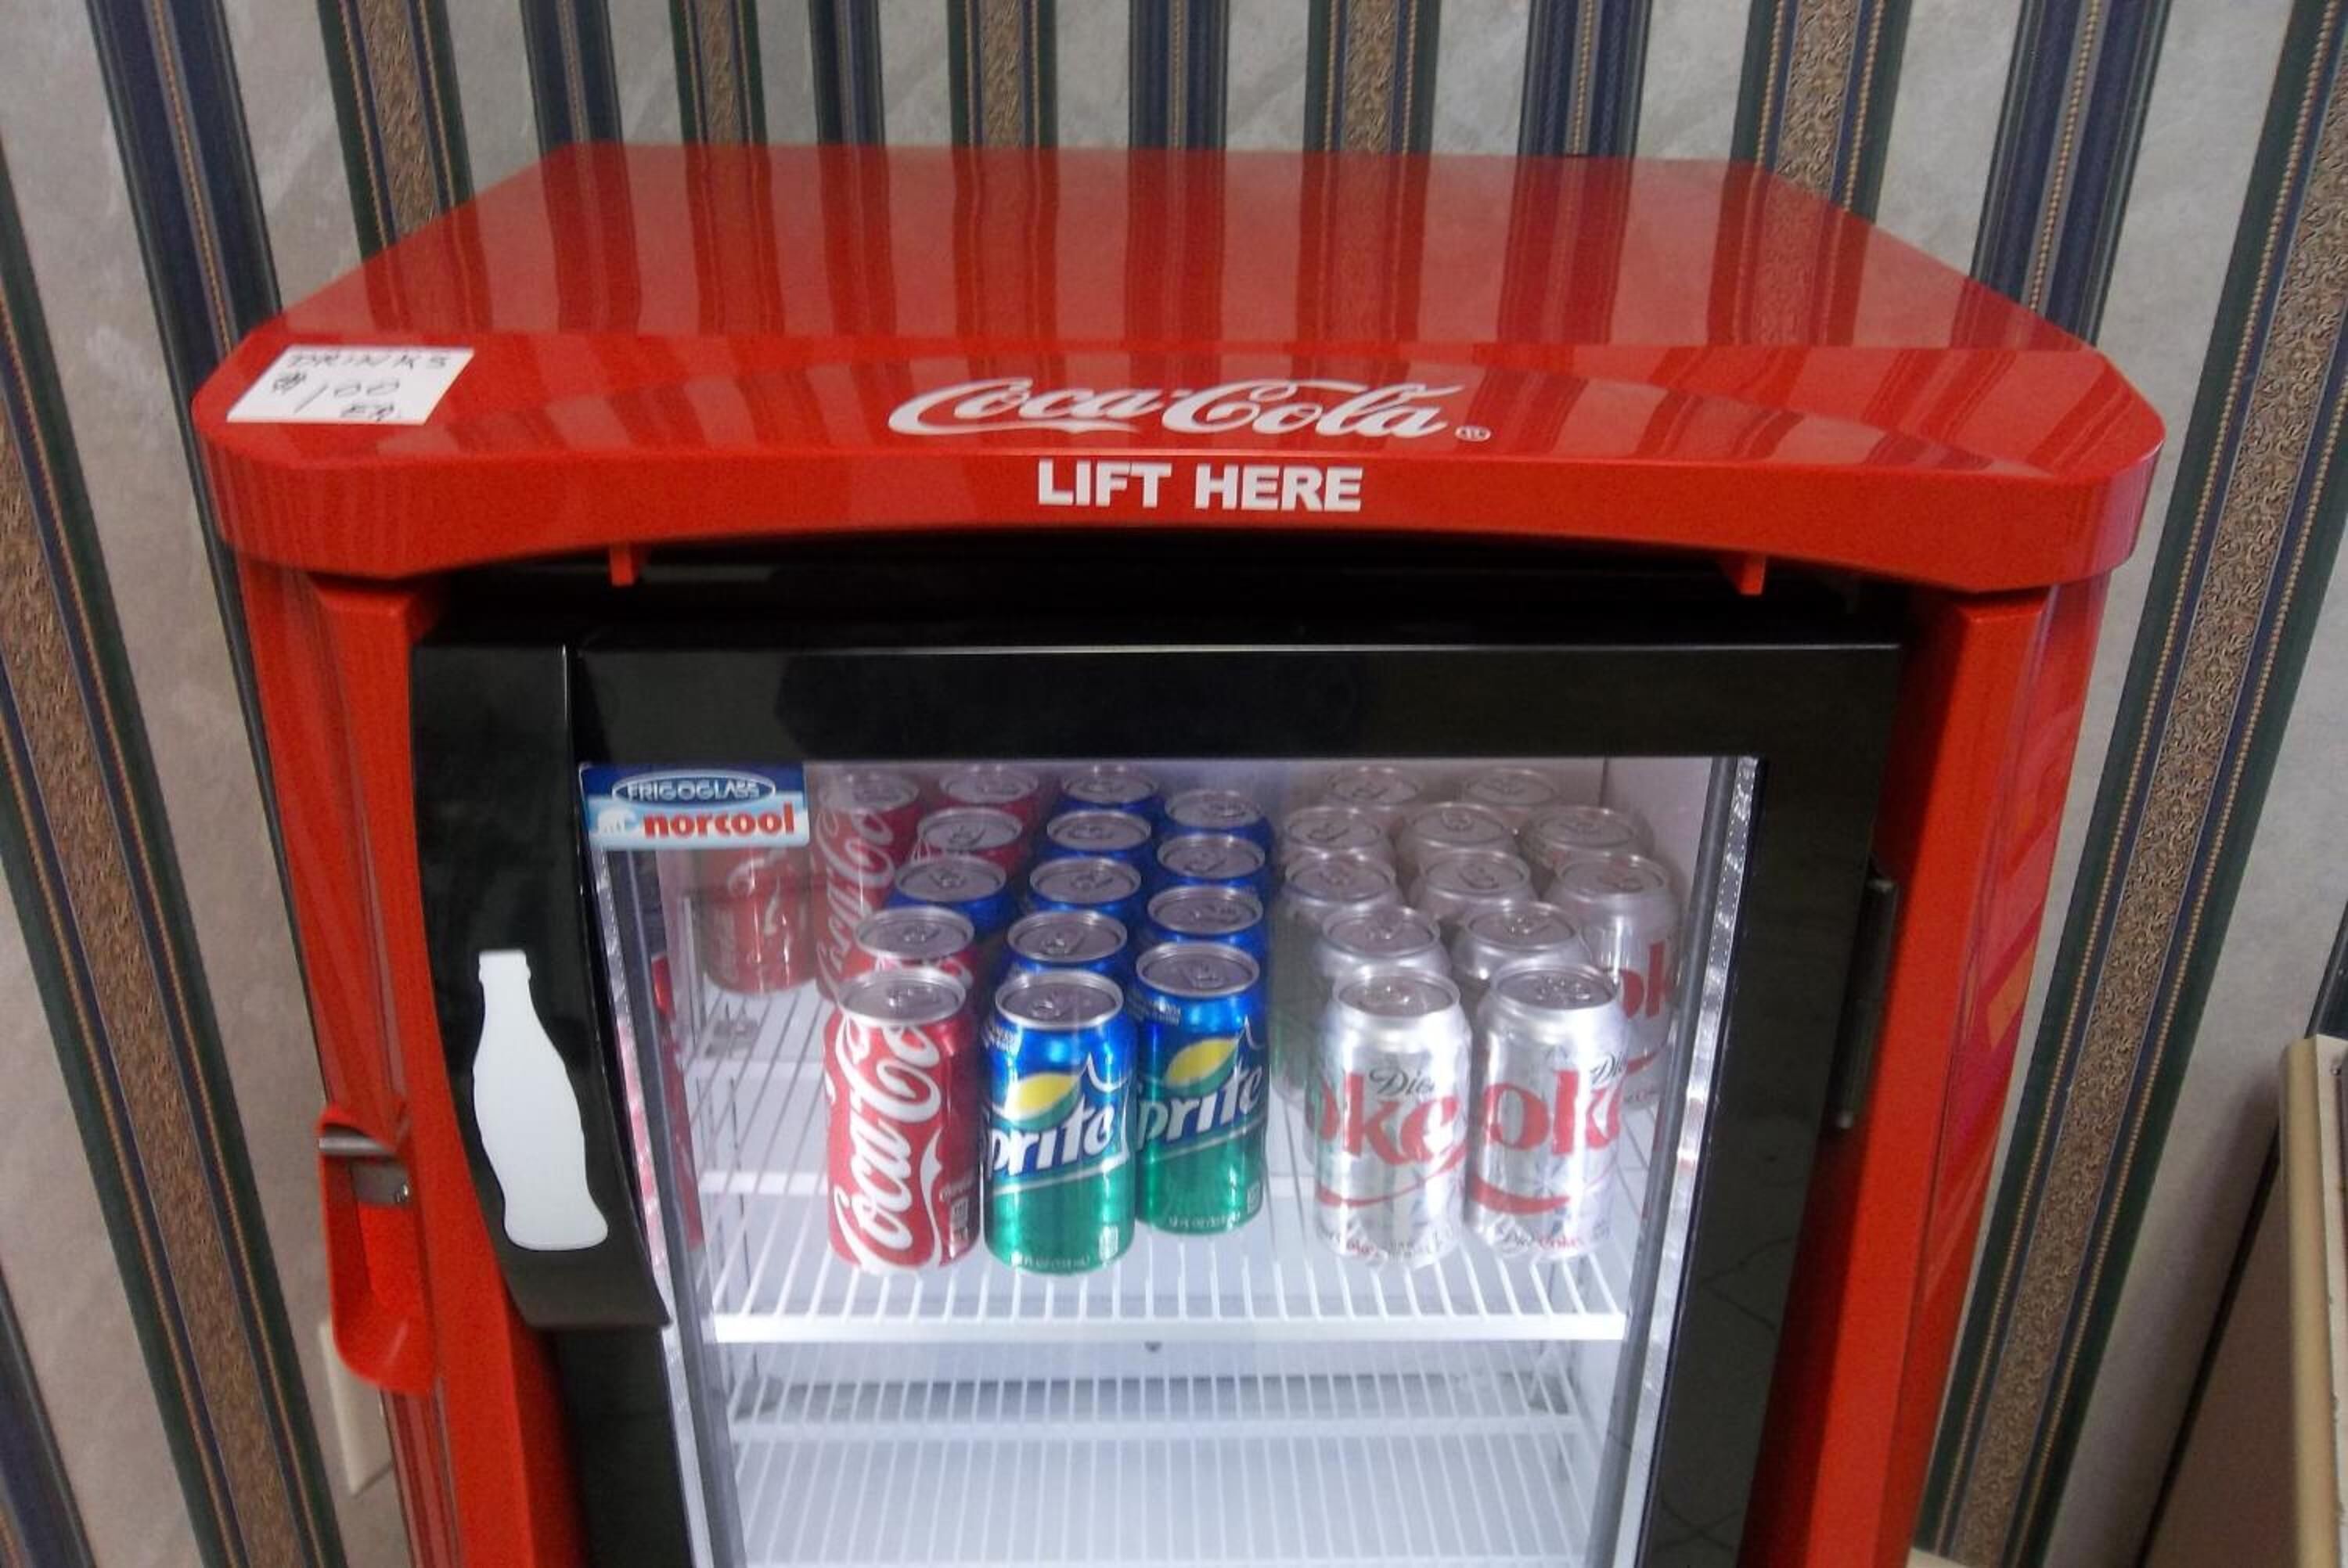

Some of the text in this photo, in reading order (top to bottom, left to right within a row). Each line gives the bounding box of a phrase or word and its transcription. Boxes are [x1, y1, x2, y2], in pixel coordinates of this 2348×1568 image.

[888, 377, 1464, 438] Coca-Cola
[1037, 459, 1363, 512] LIFT HERE
[626, 779, 761, 801] FRIGOGLASS
[643, 800, 795, 839] norcool
[1138, 1053, 1263, 1153] prite
[984, 1094, 1115, 1180] prite
